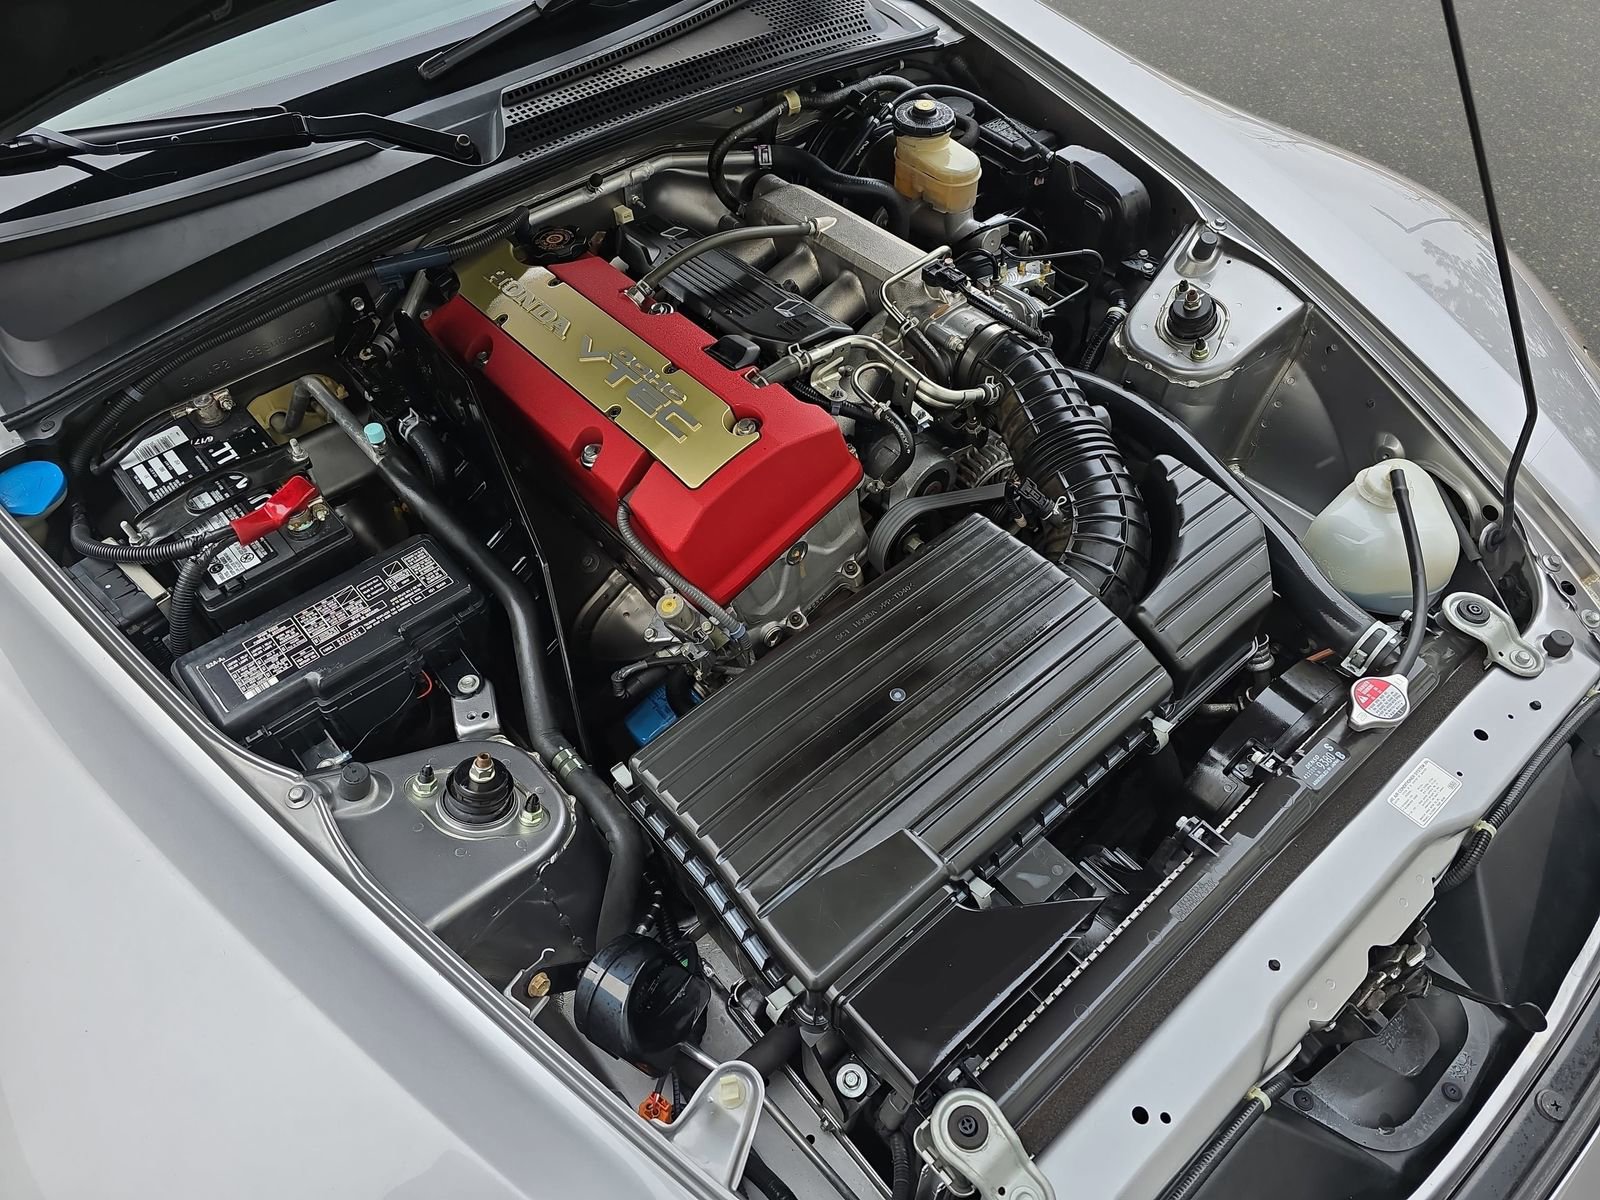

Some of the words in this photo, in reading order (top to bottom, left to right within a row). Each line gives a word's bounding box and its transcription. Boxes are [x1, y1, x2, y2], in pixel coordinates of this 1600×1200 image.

[484, 269, 572, 341] HONDA
[612, 346, 688, 405] DOHC
[578, 334, 703, 444] VTEC
[852, 607, 877, 629] HONDA
[1323, 741, 1334, 752] S
[1334, 749, 1345, 761] B
[1304, 754, 1320, 769] DENSO
